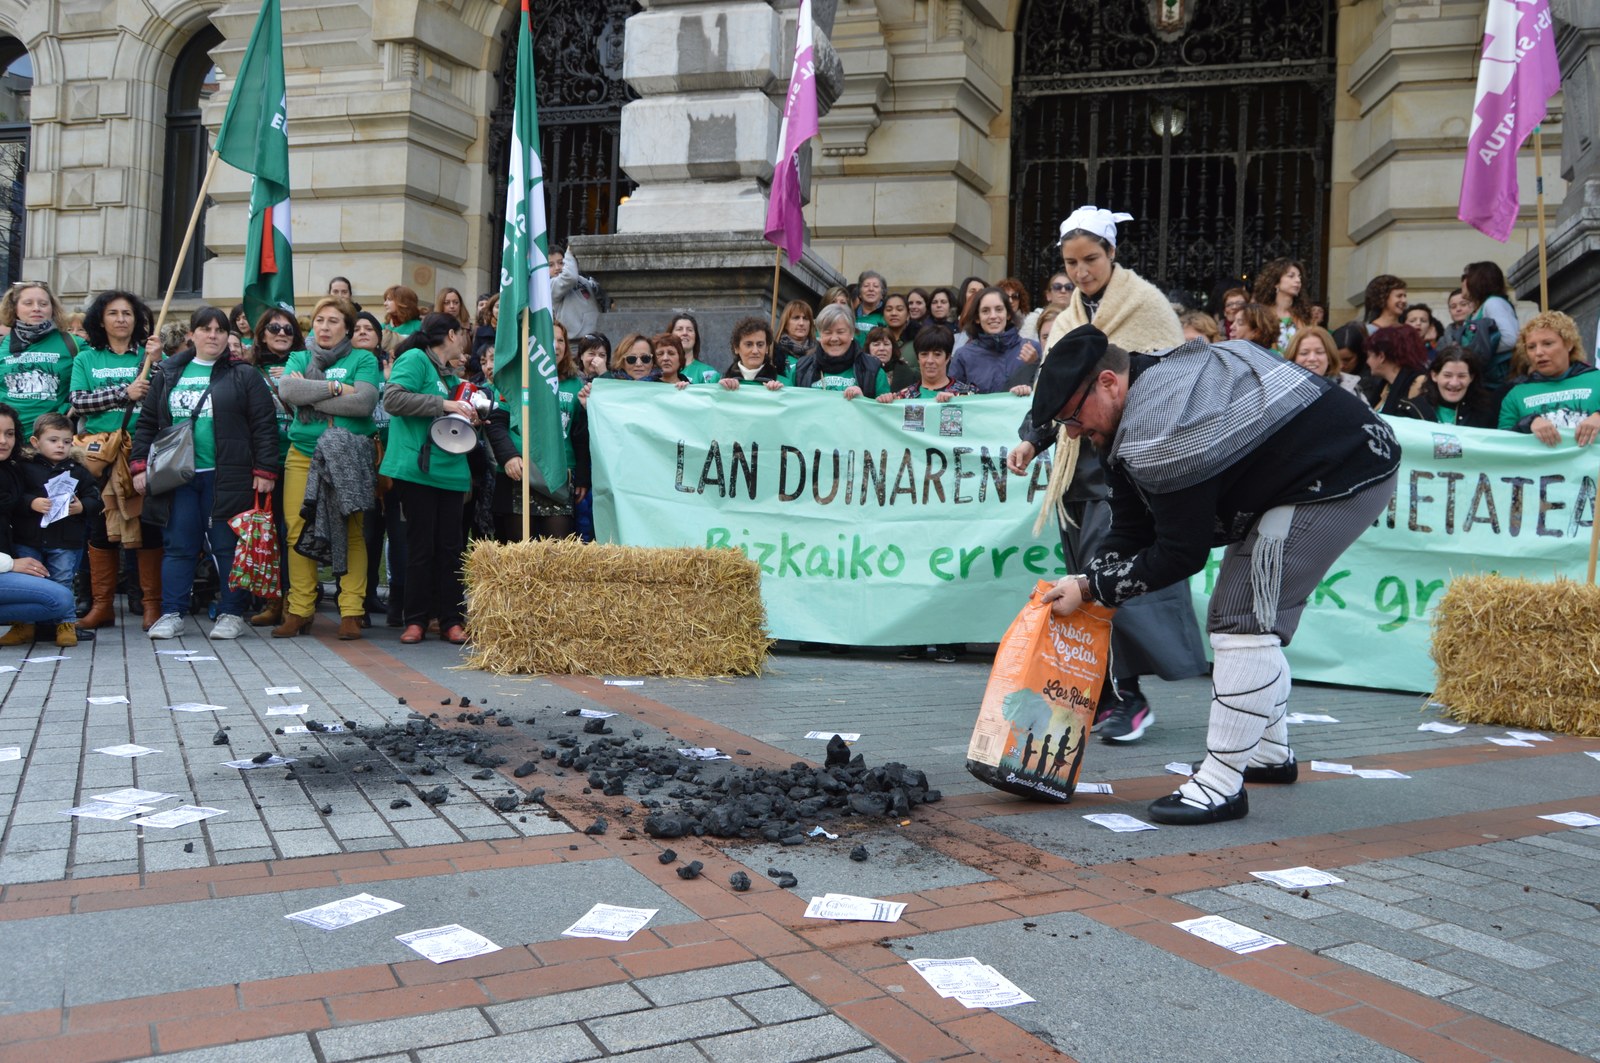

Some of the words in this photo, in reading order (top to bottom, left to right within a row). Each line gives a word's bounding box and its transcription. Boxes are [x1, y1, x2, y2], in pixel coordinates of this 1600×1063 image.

[674, 439, 759, 500] LAN
[778, 443, 1008, 507] DUINAREN
[705, 527, 907, 580] Bizkaiko
[1042, 678, 1070, 702] Los
